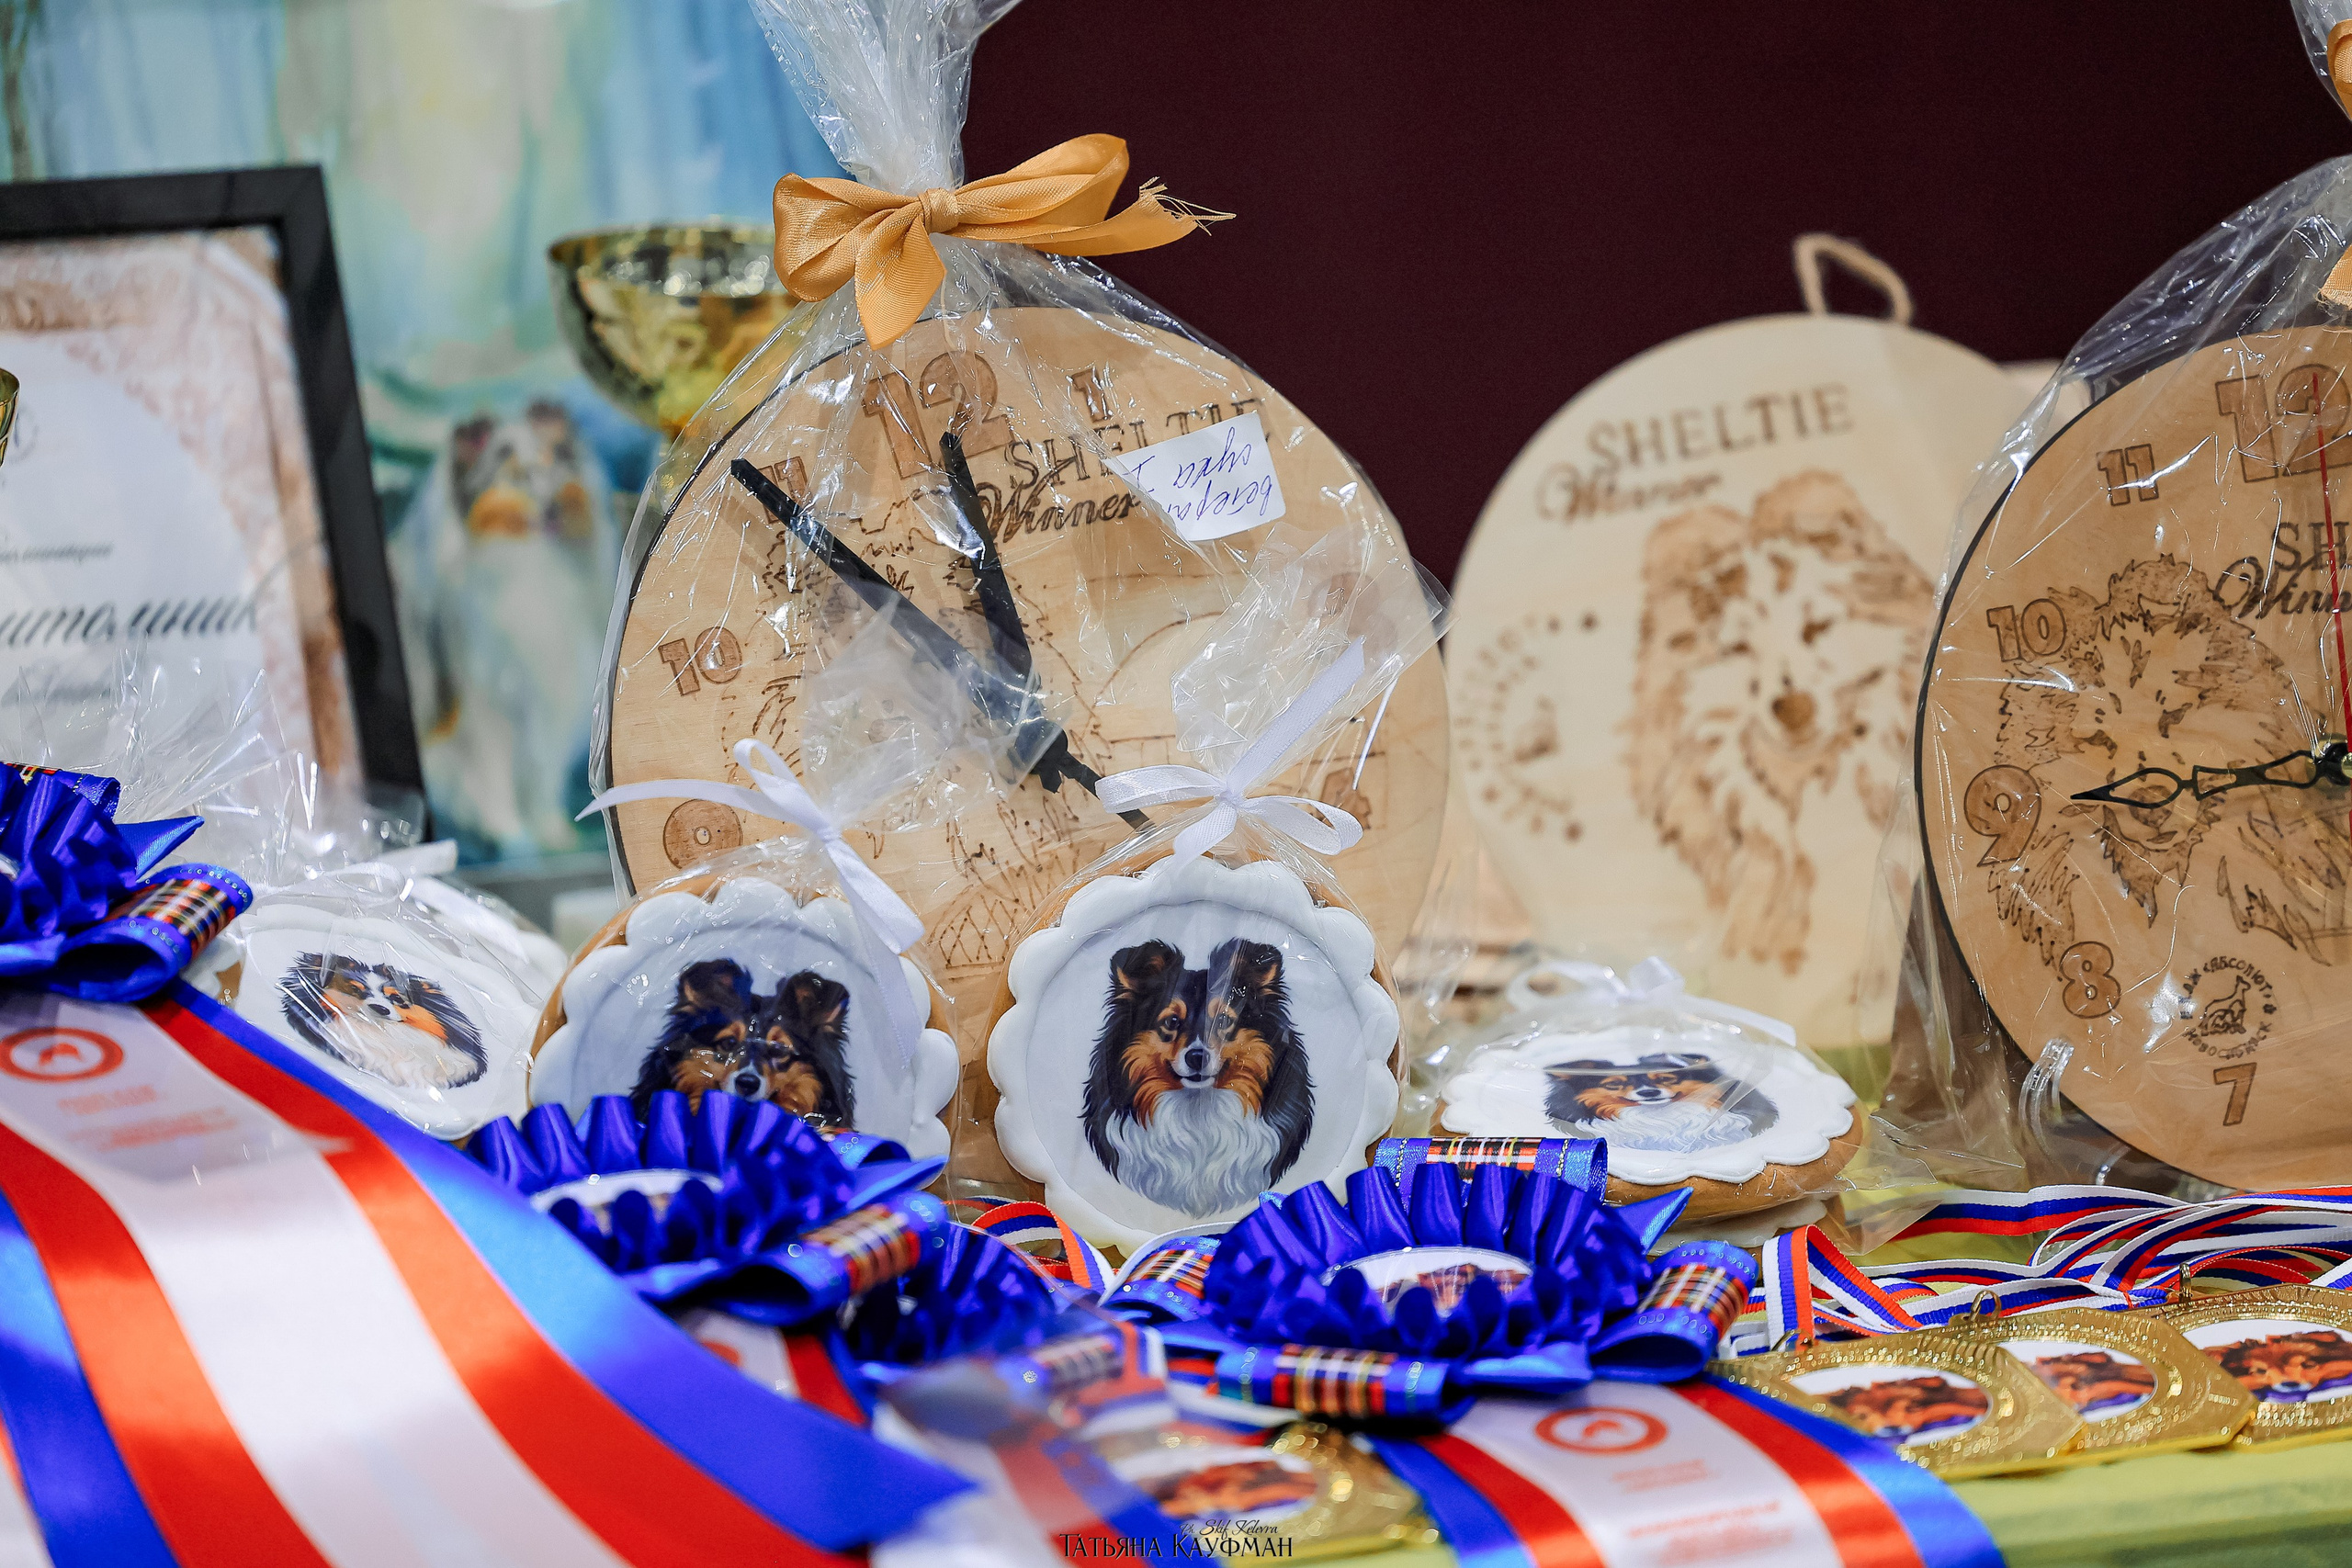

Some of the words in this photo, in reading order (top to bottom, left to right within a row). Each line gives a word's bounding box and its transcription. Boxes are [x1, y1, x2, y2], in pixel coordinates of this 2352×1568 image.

[861, 350, 1012, 480] 12
[1587, 382, 1856, 475] SHELTIE
[2215, 364, 2352, 483] 12
[1172, 427, 1252, 489] сука
[2096, 444, 2159, 506] 11
[976, 462, 1141, 544] Winner
[658, 626, 742, 696] 10
[1986, 598, 2067, 662] 10
[1963, 764, 2041, 867] 9
[2059, 941, 2121, 1019] 8
[2213, 1062, 2256, 1126] 7
